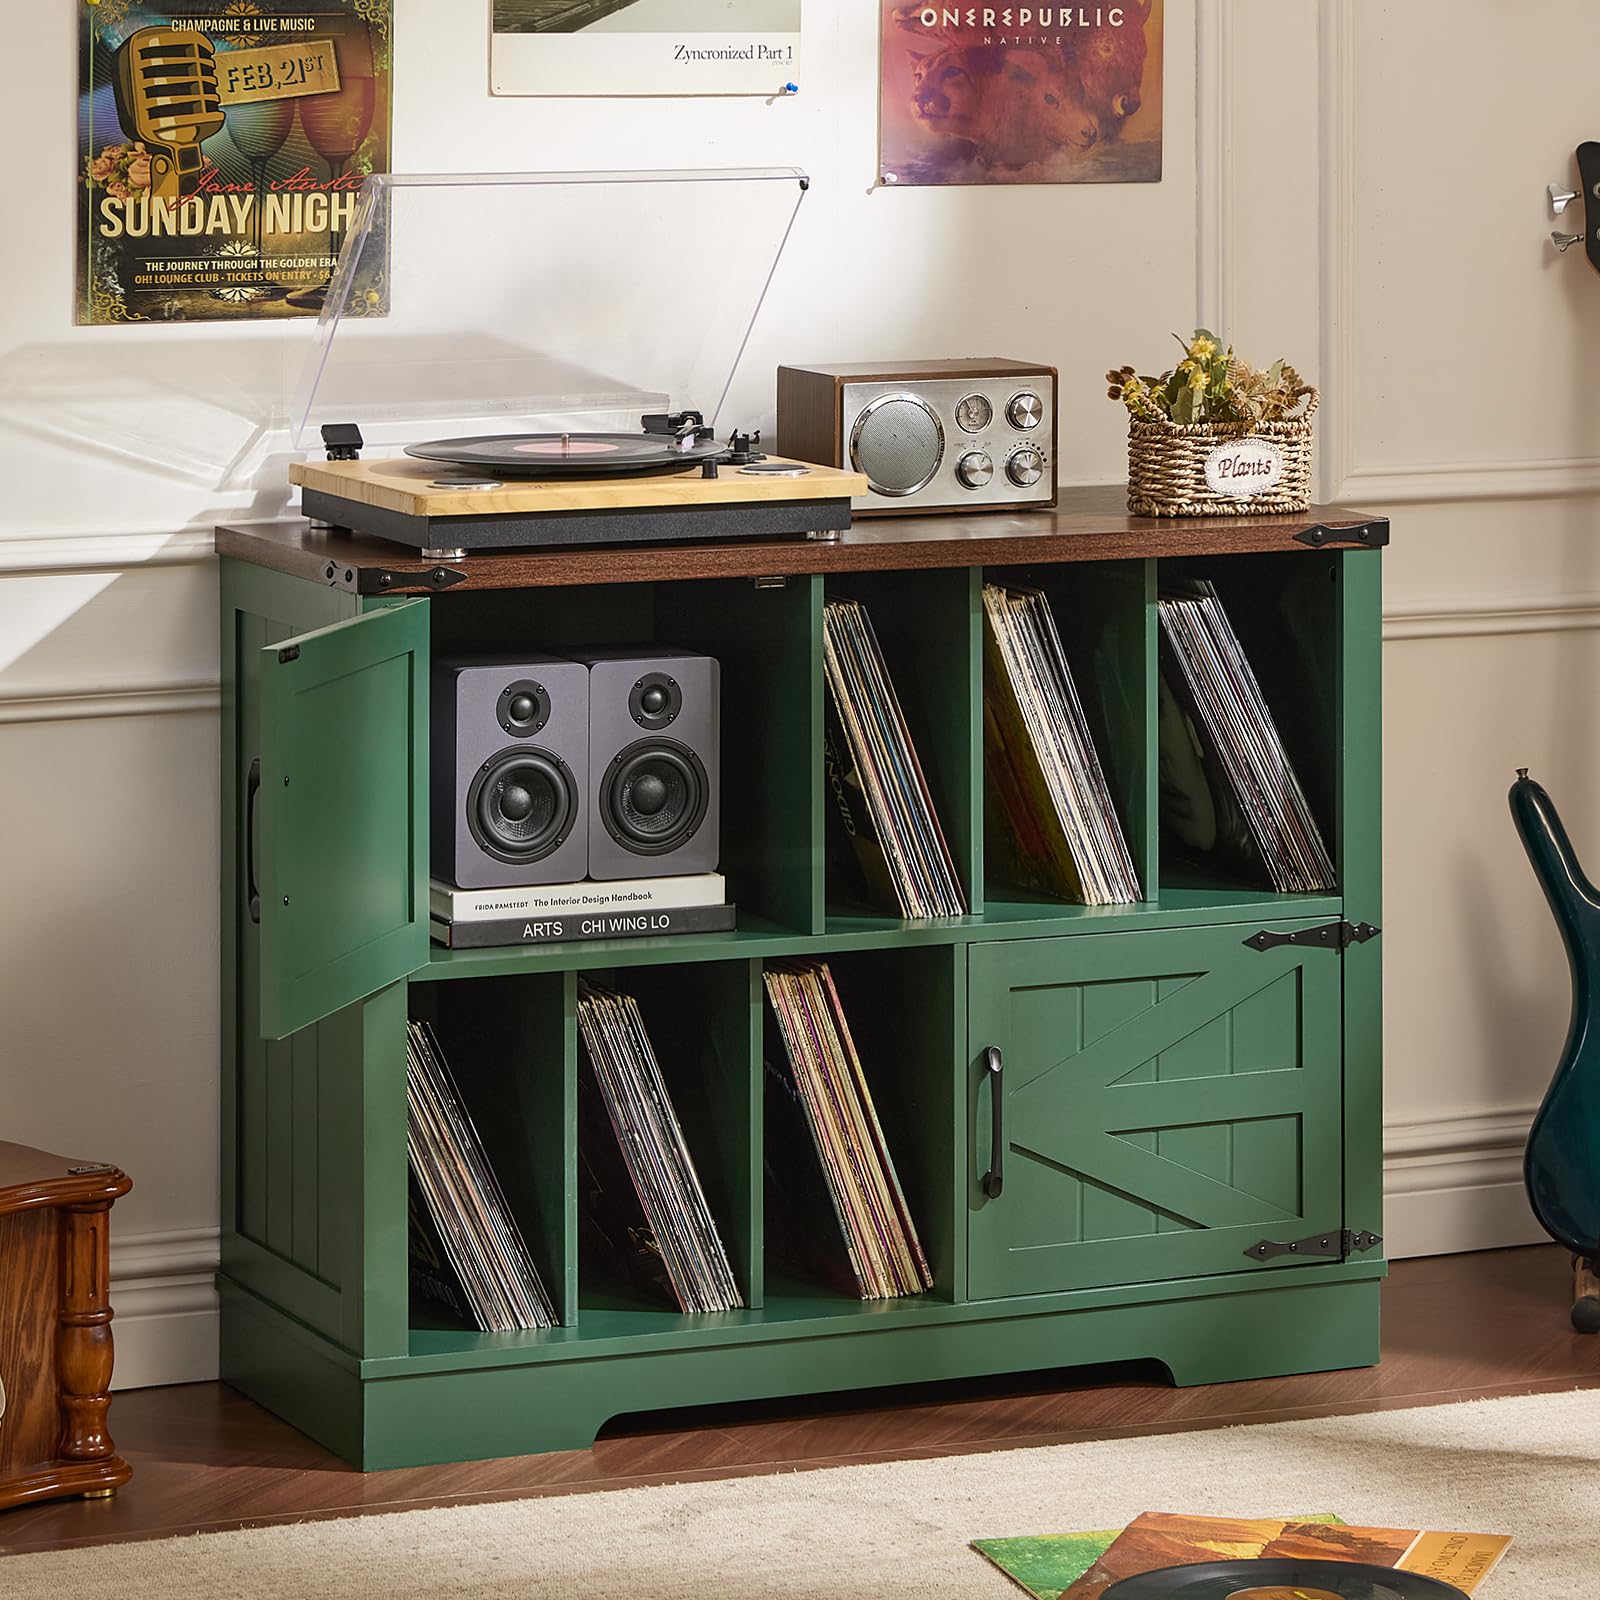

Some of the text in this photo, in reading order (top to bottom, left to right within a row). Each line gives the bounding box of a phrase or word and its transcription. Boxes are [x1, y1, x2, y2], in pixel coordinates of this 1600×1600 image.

[171, 18, 315, 32] CHAMPAGNE & LIVE MUSIC
[921, 8, 1124, 27] ONEREPUBLIC
[983, 36, 1062, 45] NATIVE
[674, 45, 793, 65] Zyncronized Part 1
[169, 168, 257, 212] Jane
[100, 192, 361, 237] SUNDAY NIGH
[145, 257, 338, 271] THE JOURNEY THROUGH THE GOLDEN ERA
[135, 275, 153, 284] OH!
[154, 274, 193, 284] LOUNGE
[194, 273, 219, 283] CLUB
[226, 271, 264, 282] TICKETS
[265, 271, 279, 281] ON
[281, 270, 312, 280] ENTRY
[1218, 454, 1272, 479] Plants
[534, 891, 652, 907] The Interior Design Handbook
[522, 914, 670, 938] ARTS CHI WING LO
